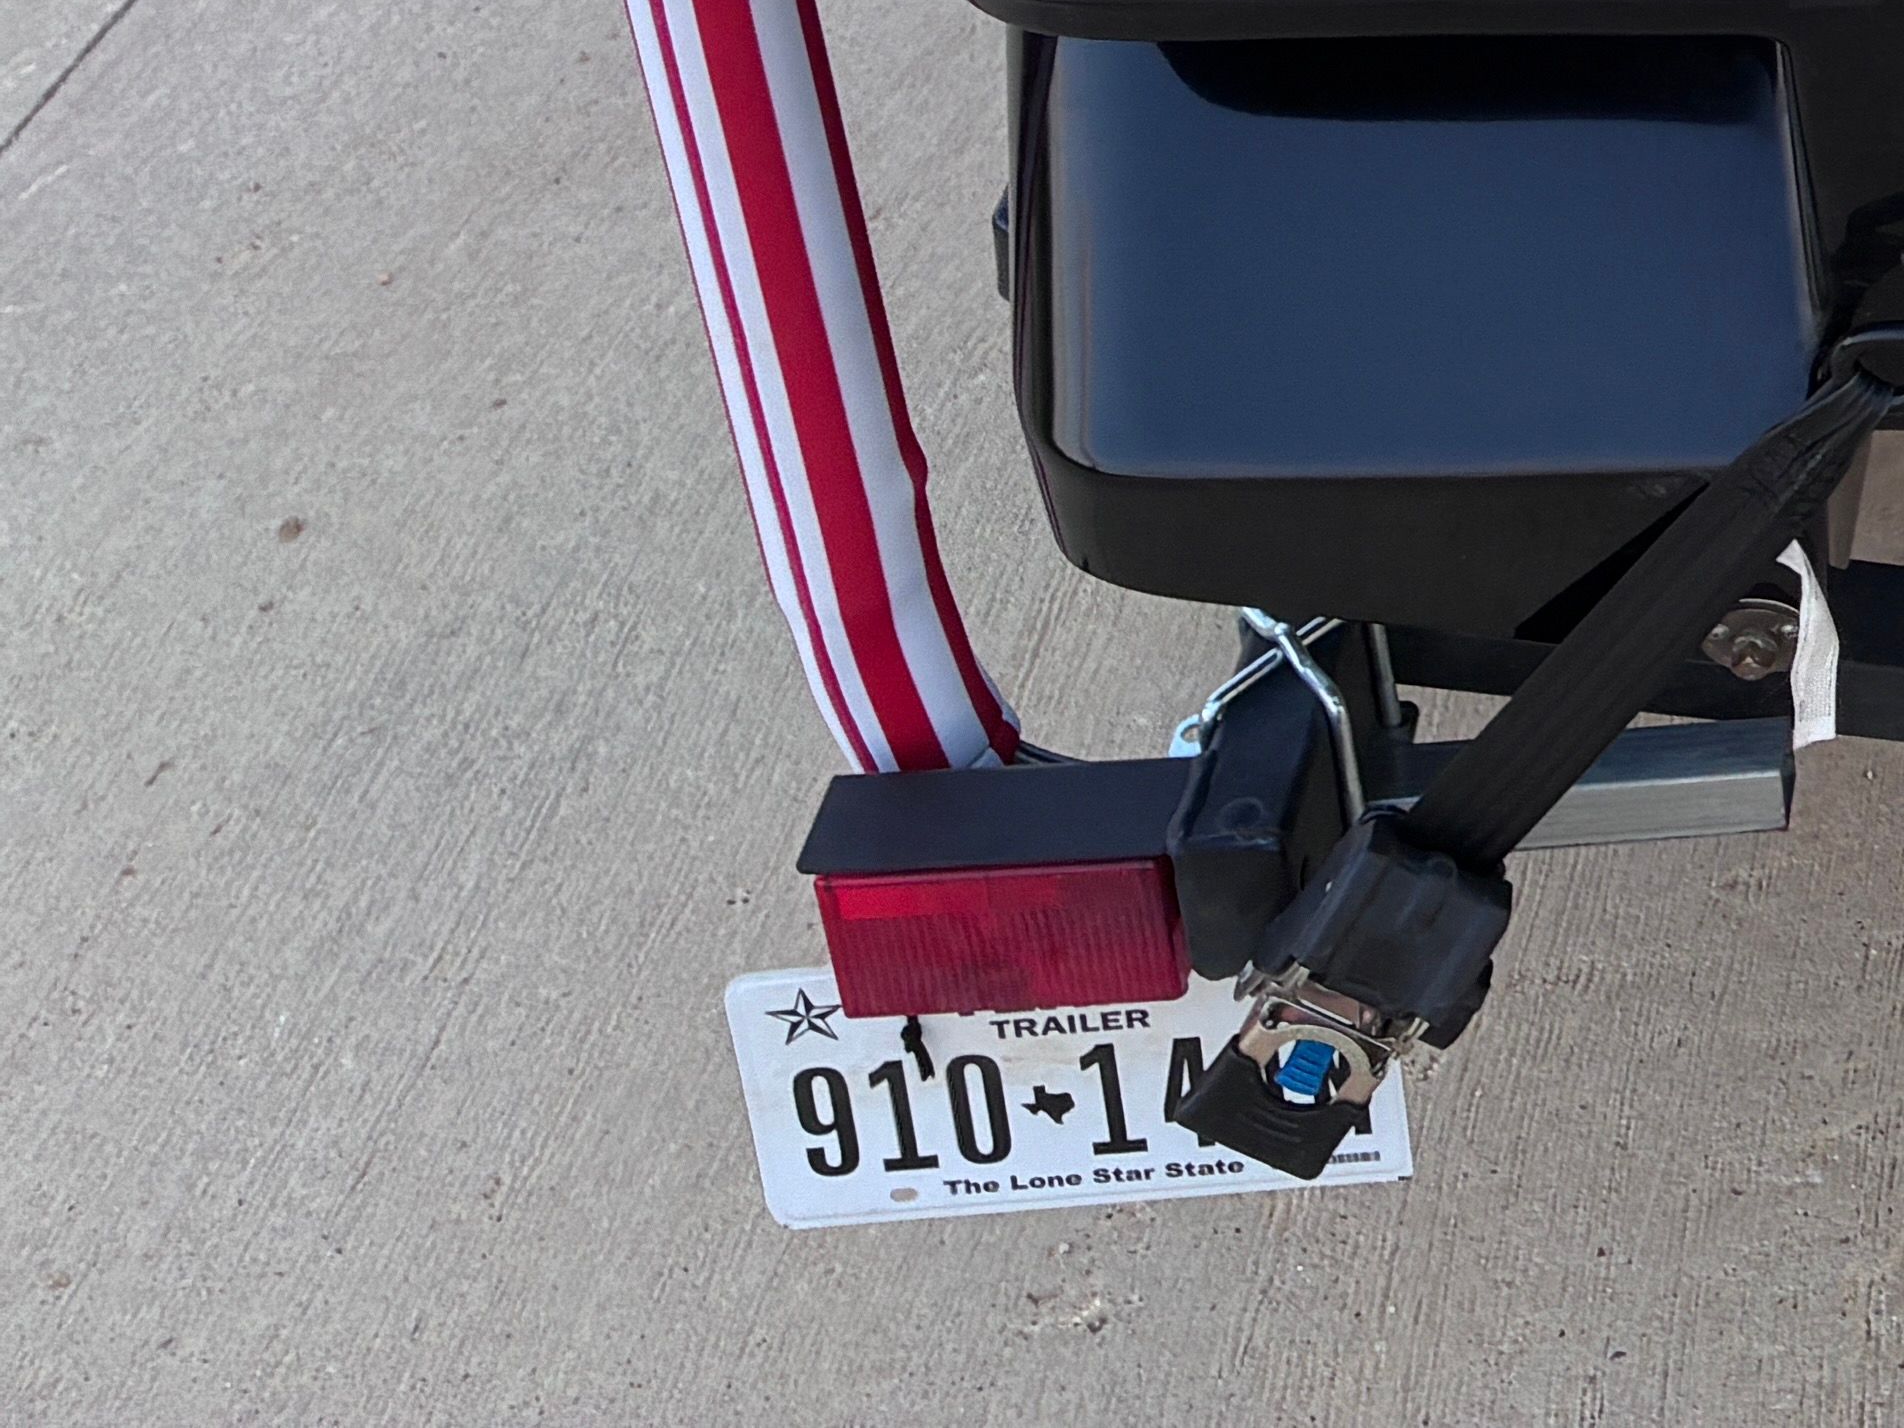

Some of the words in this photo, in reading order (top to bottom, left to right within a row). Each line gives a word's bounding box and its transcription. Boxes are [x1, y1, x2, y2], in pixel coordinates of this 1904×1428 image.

[989, 1008, 1151, 1040] TRAILER
[792, 1053, 1013, 1178] 910
[942, 1178, 1000, 1196] The
[1010, 1171, 1083, 1192] Lone
[1092, 1165, 1156, 1184] Star
[1164, 1157, 1245, 1178] State
